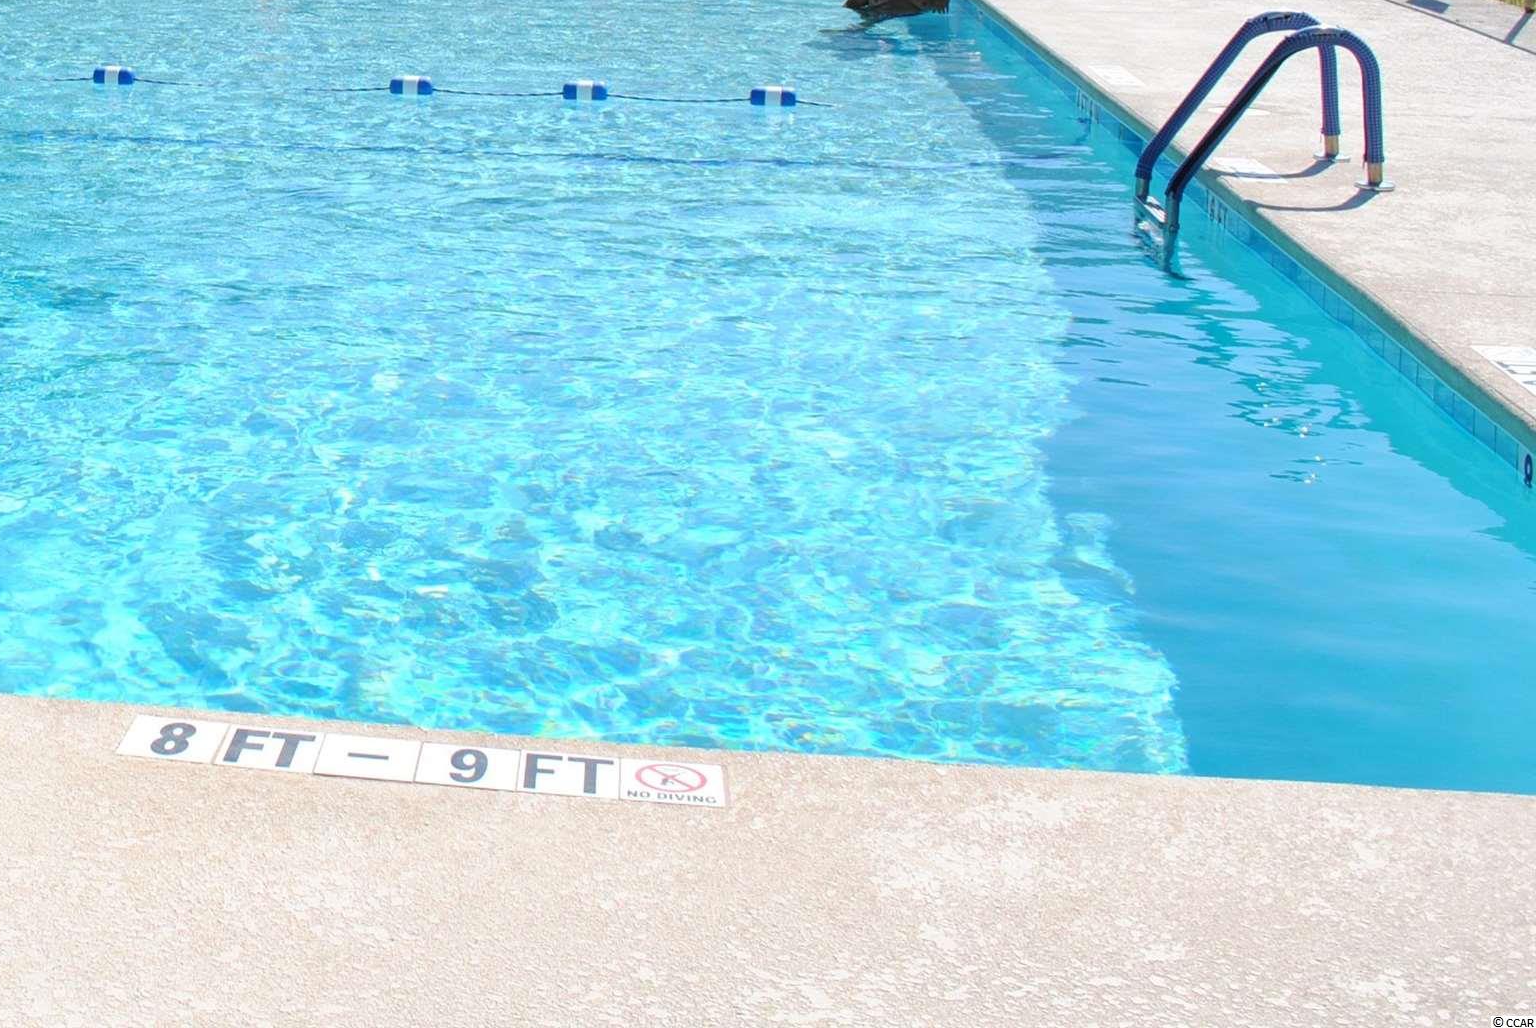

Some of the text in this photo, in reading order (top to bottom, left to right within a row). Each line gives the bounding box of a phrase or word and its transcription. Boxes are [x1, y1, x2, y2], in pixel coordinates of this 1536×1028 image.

[150, 722, 197, 755] 8
[223, 728, 316, 768] FT
[449, 748, 489, 783] 9
[523, 752, 614, 794] FT
[627, 789, 717, 804] NO DIVING
